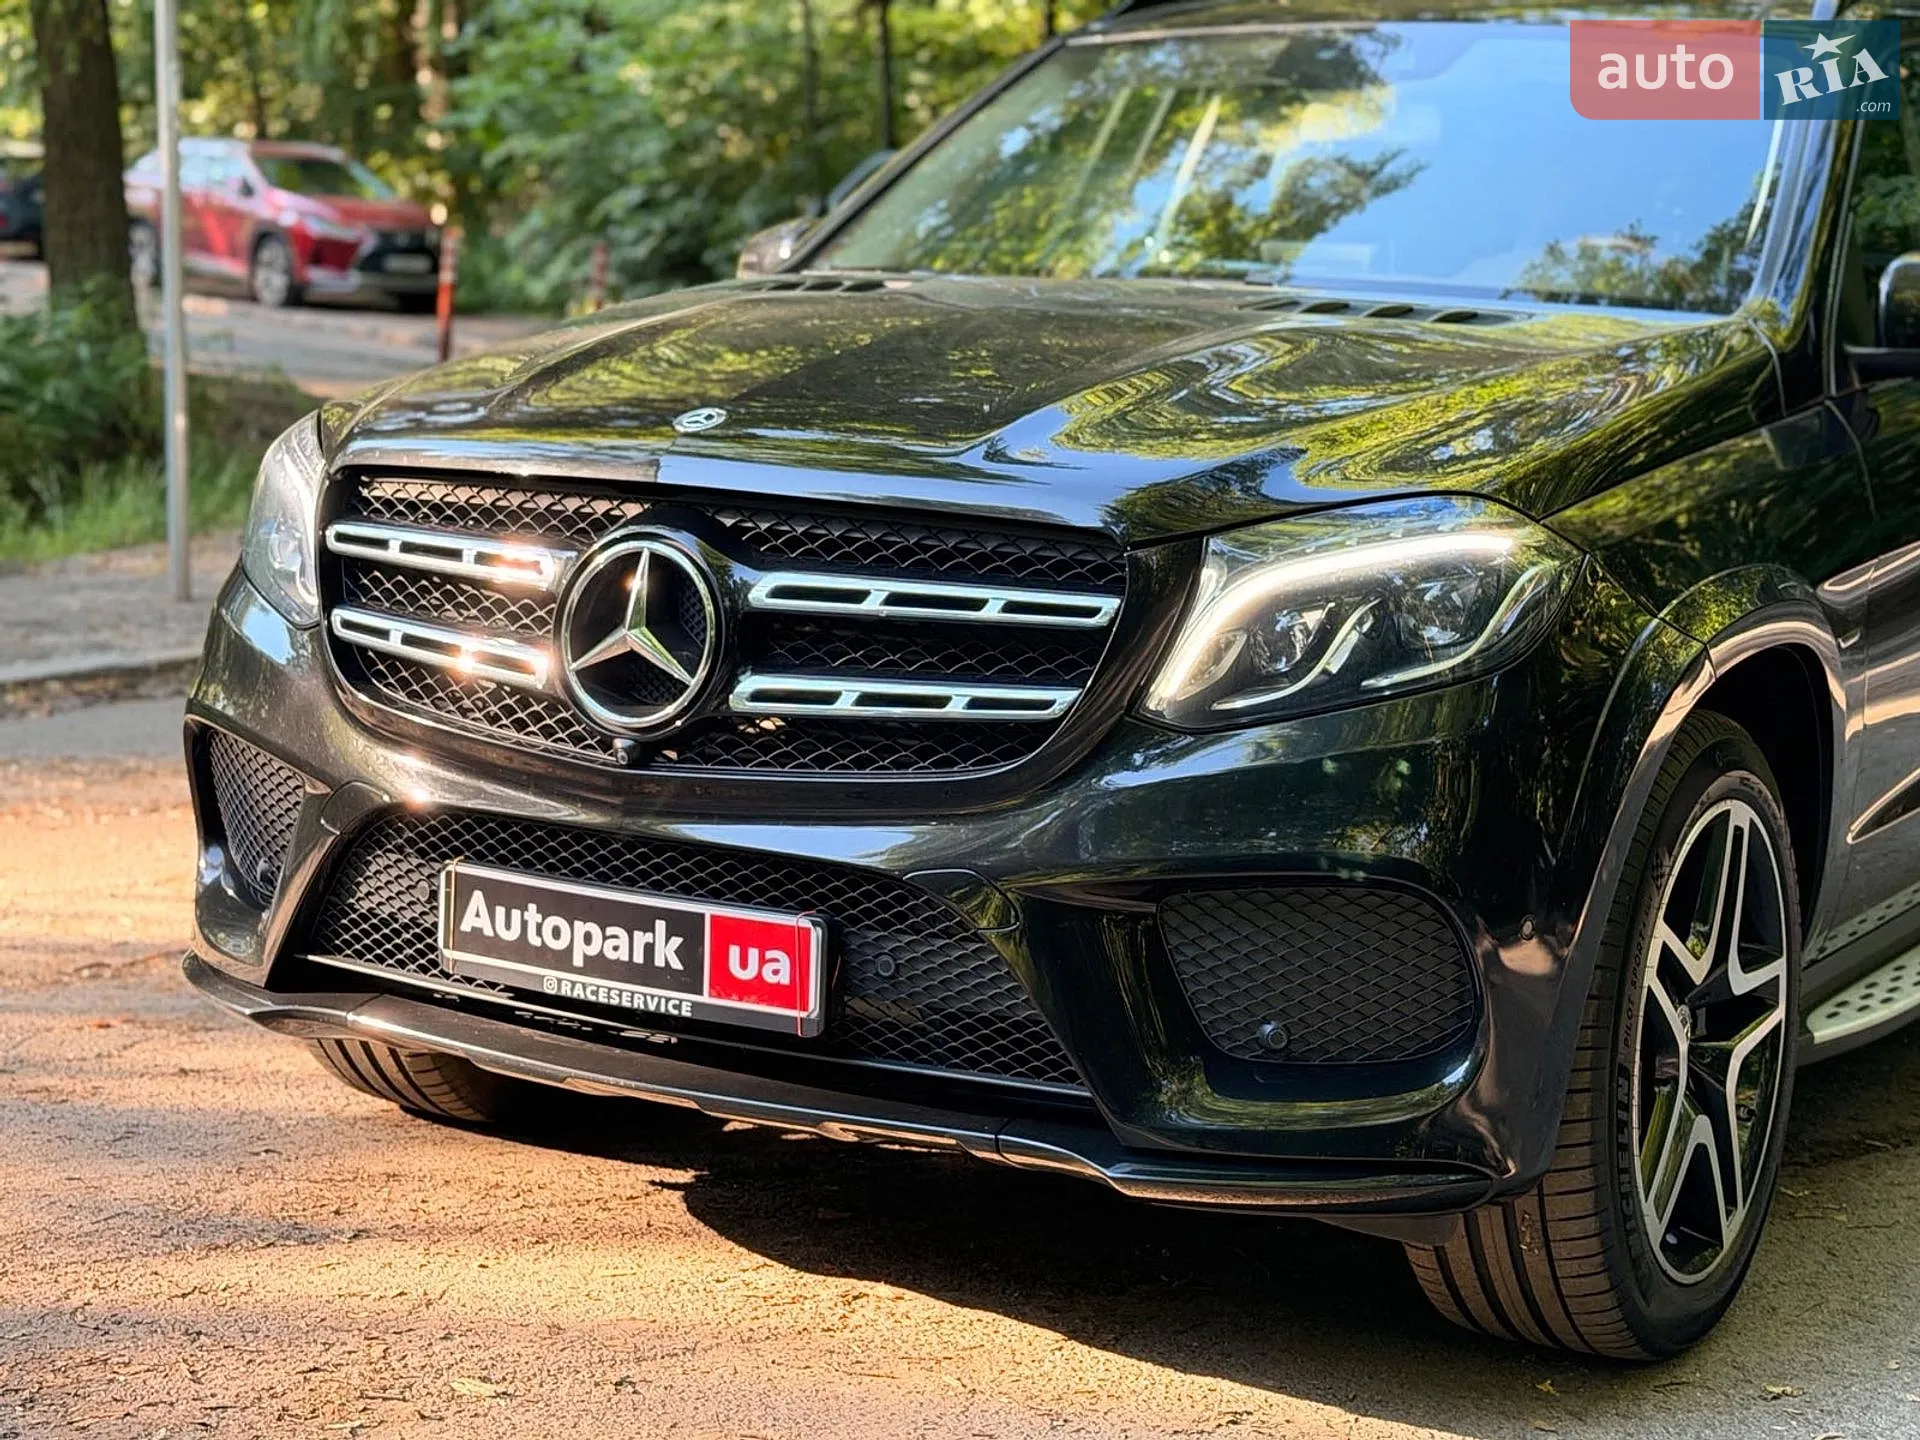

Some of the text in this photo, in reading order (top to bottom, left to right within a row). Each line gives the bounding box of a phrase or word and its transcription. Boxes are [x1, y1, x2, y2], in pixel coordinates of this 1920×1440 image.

[460, 890, 791, 986] Autopark ua
[561, 980, 693, 1017] RACESERVICE
[1623, 929, 1645, 1048] PILOT SPORT
